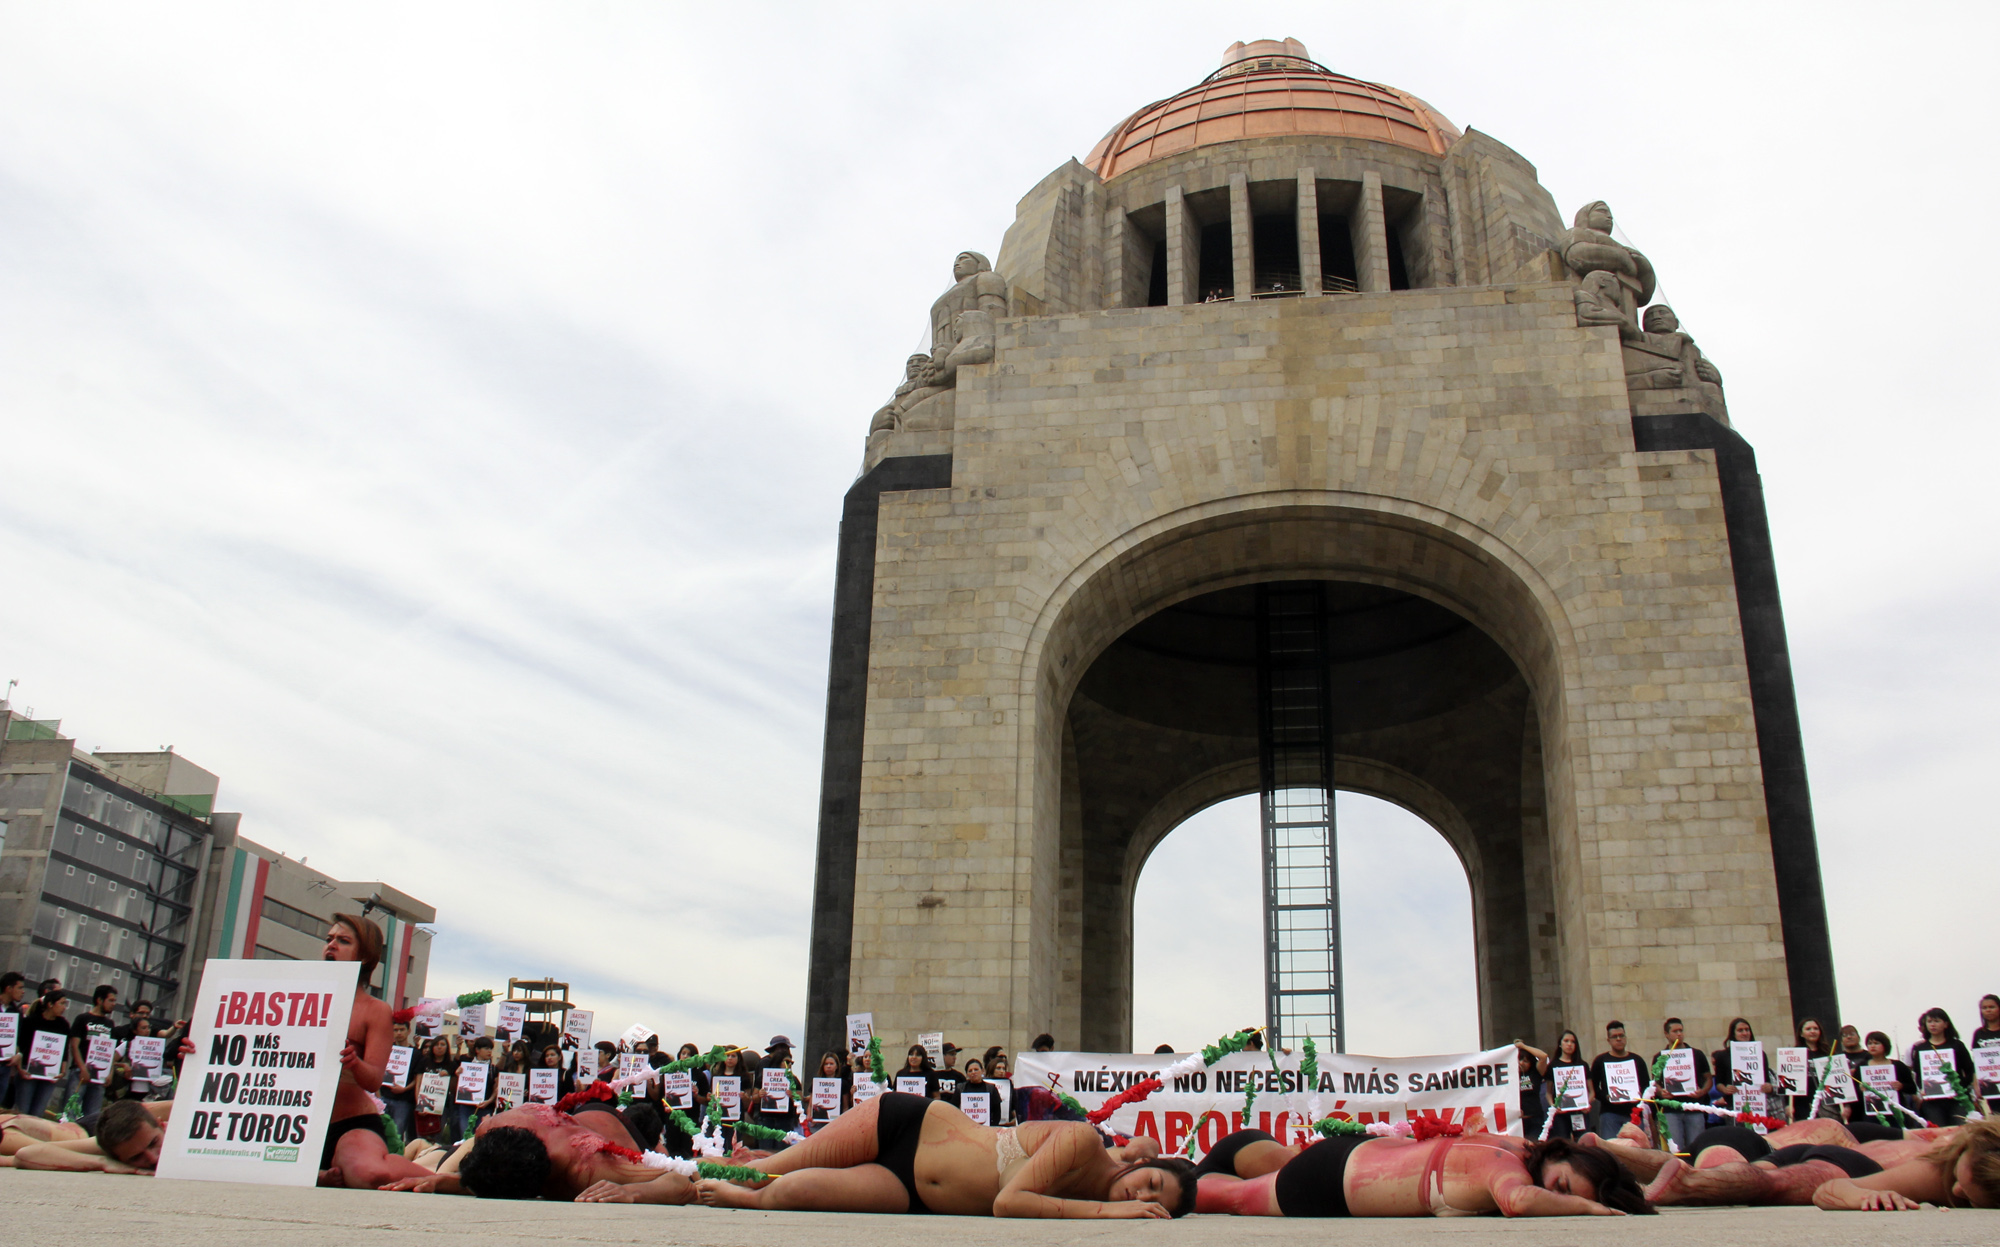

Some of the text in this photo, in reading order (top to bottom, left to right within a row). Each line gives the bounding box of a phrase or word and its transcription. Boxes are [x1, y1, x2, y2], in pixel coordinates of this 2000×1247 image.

[214, 992, 333, 1028] ¡BASTA!
[253, 1033, 281, 1049] MÁS
[35, 1047, 60, 1055] TOREROS
[209, 1034, 247, 1066] NO
[252, 1051, 316, 1069] TORTURA
[1746, 1062, 1758, 1070] NO
[1781, 1064, 1792, 1072] NO
[243, 1073, 277, 1087] A LAS
[1174, 1071, 1207, 1093] NO
[1343, 1067, 1400, 1095] MÁS
[1408, 1063, 1509, 1093] SANGRE
[1611, 1076, 1623, 1084] NO
[1834, 1075, 1847, 1084] NO
[200, 1072, 240, 1104] NO
[423, 1086, 435, 1094] NO
[239, 1088, 312, 1107] CORRIDAS
[189, 1111, 308, 1144] DE TOROS
